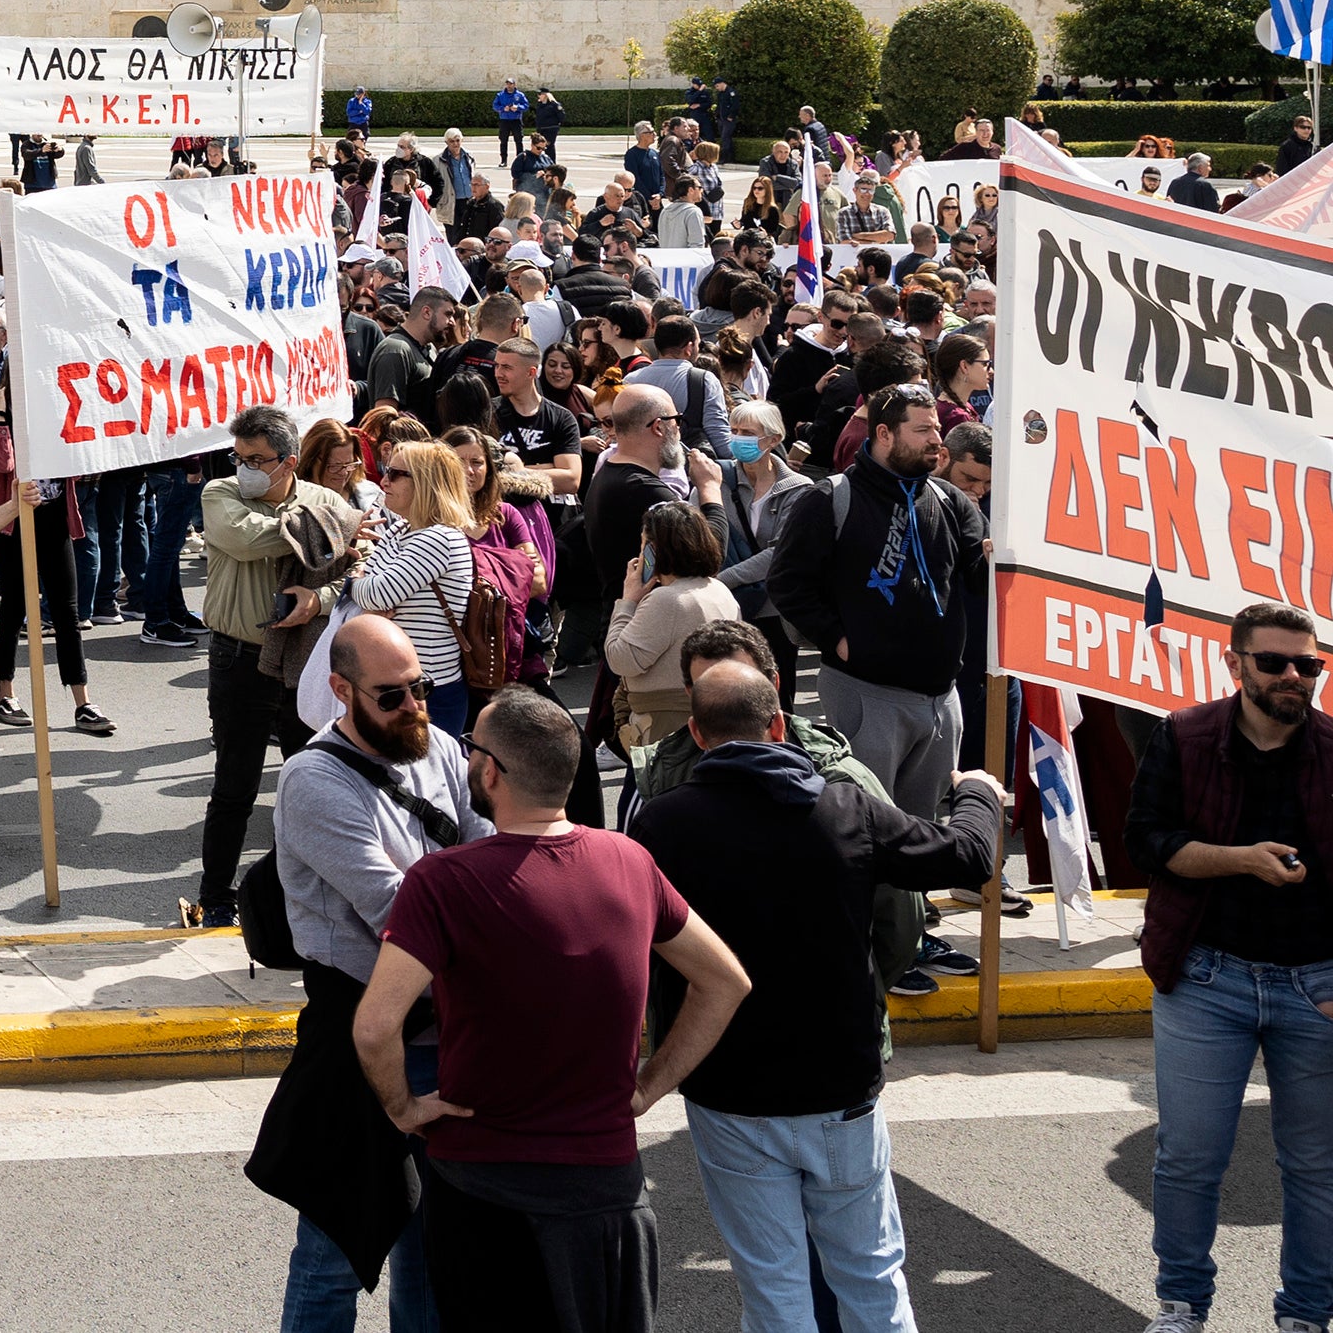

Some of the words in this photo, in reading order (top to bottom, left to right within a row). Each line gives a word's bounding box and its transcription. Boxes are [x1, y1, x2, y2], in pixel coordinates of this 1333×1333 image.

[17, 47, 107, 81] ΛΑΟΣ
[127, 48, 168, 81] ΘΑ
[188, 48, 298, 81] ΝΙΚΗΣΕΙ
[124, 190, 178, 249] ΟΙ
[230, 176, 328, 238] ΝΕΚΡΟΙ
[131, 259, 192, 327] ΤΑ
[244, 241, 329, 312] ΚΕΡΔΗ
[1035, 228, 1103, 373] ΟΙ
[56, 338, 277, 444] ΣΩΜΑΤΕΙΟ
[1044, 408, 1211, 581] ΔΕΝ
[1044, 596, 1241, 701] ΕΡΓΑΤΙΚ
